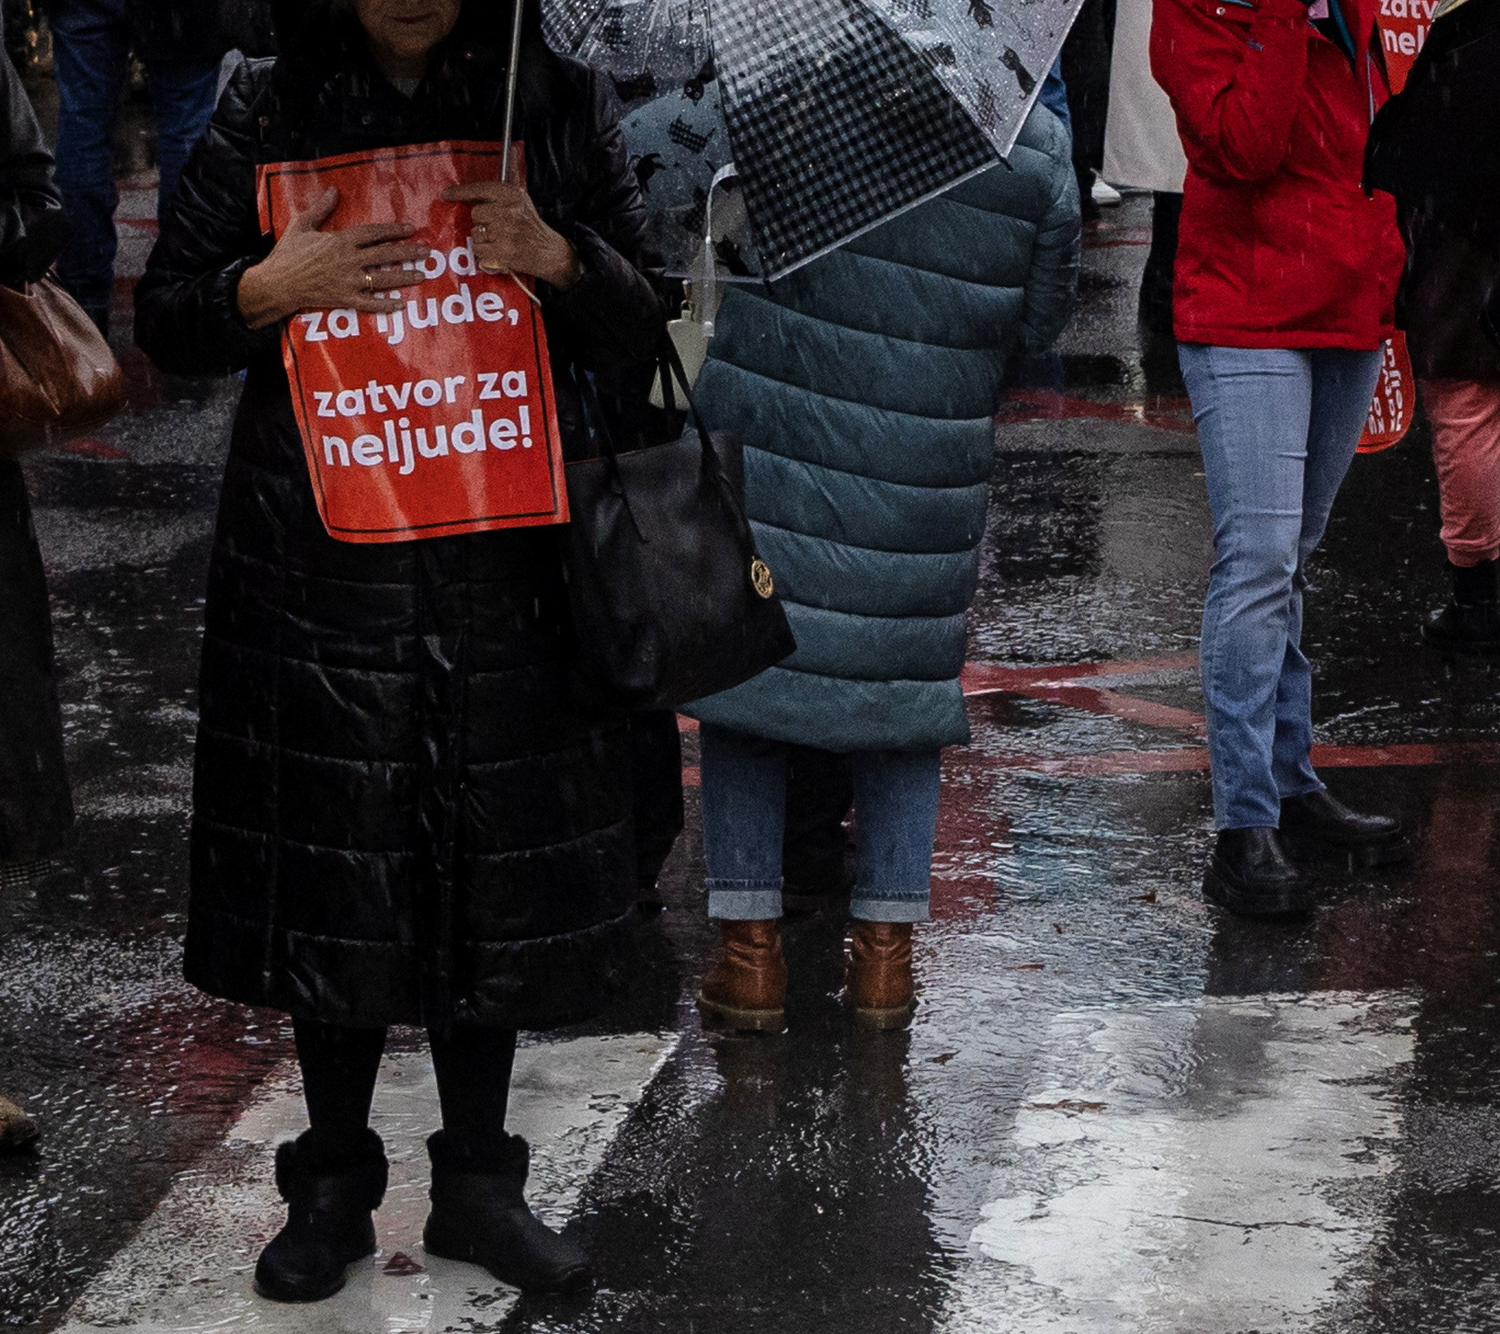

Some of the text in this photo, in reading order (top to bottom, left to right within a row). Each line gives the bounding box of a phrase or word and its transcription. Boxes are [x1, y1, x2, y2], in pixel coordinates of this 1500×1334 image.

[301, 308, 360, 342] za
[313, 370, 528, 418] zatvor za
[322, 405, 533, 475] neljude!
